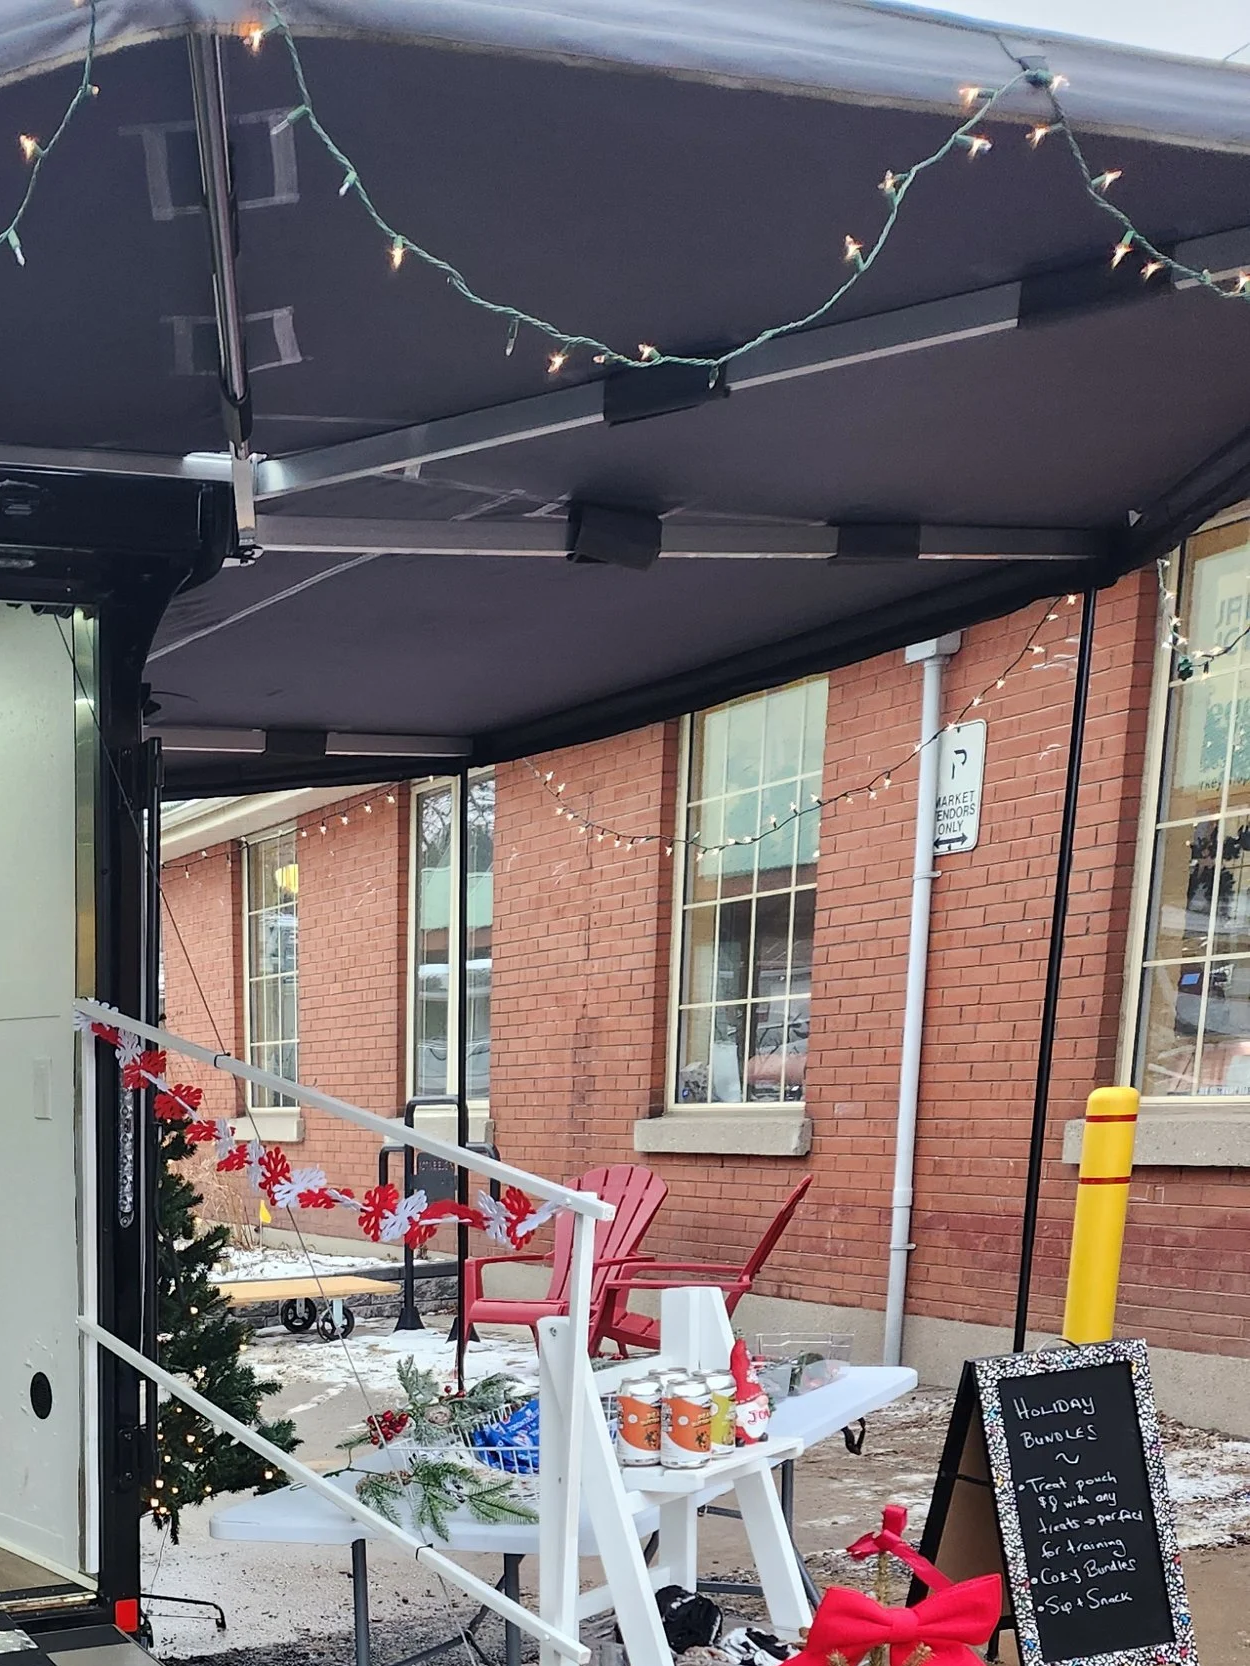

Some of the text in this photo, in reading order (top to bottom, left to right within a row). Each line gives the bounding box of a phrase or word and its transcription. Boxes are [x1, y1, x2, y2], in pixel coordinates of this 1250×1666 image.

[935, 803, 976, 821] ENDORS
[937, 820, 964, 836] ONLY
[1013, 1396, 1096, 1420] HOLIDAY
[1020, 1424, 1098, 1449] BUNDLES
[1025, 1471, 1118, 1494] Treat pouch
[1063, 1494, 1090, 1509] with
[1095, 1492, 1117, 1507] any
[1038, 1517, 1081, 1534] treats
[1041, 1538, 1127, 1559] for training
[1040, 1558, 1137, 1584] Cozy Bundles
[1044, 1595, 1073, 1615] Sip
[1086, 1587, 1133, 1609] Snack
